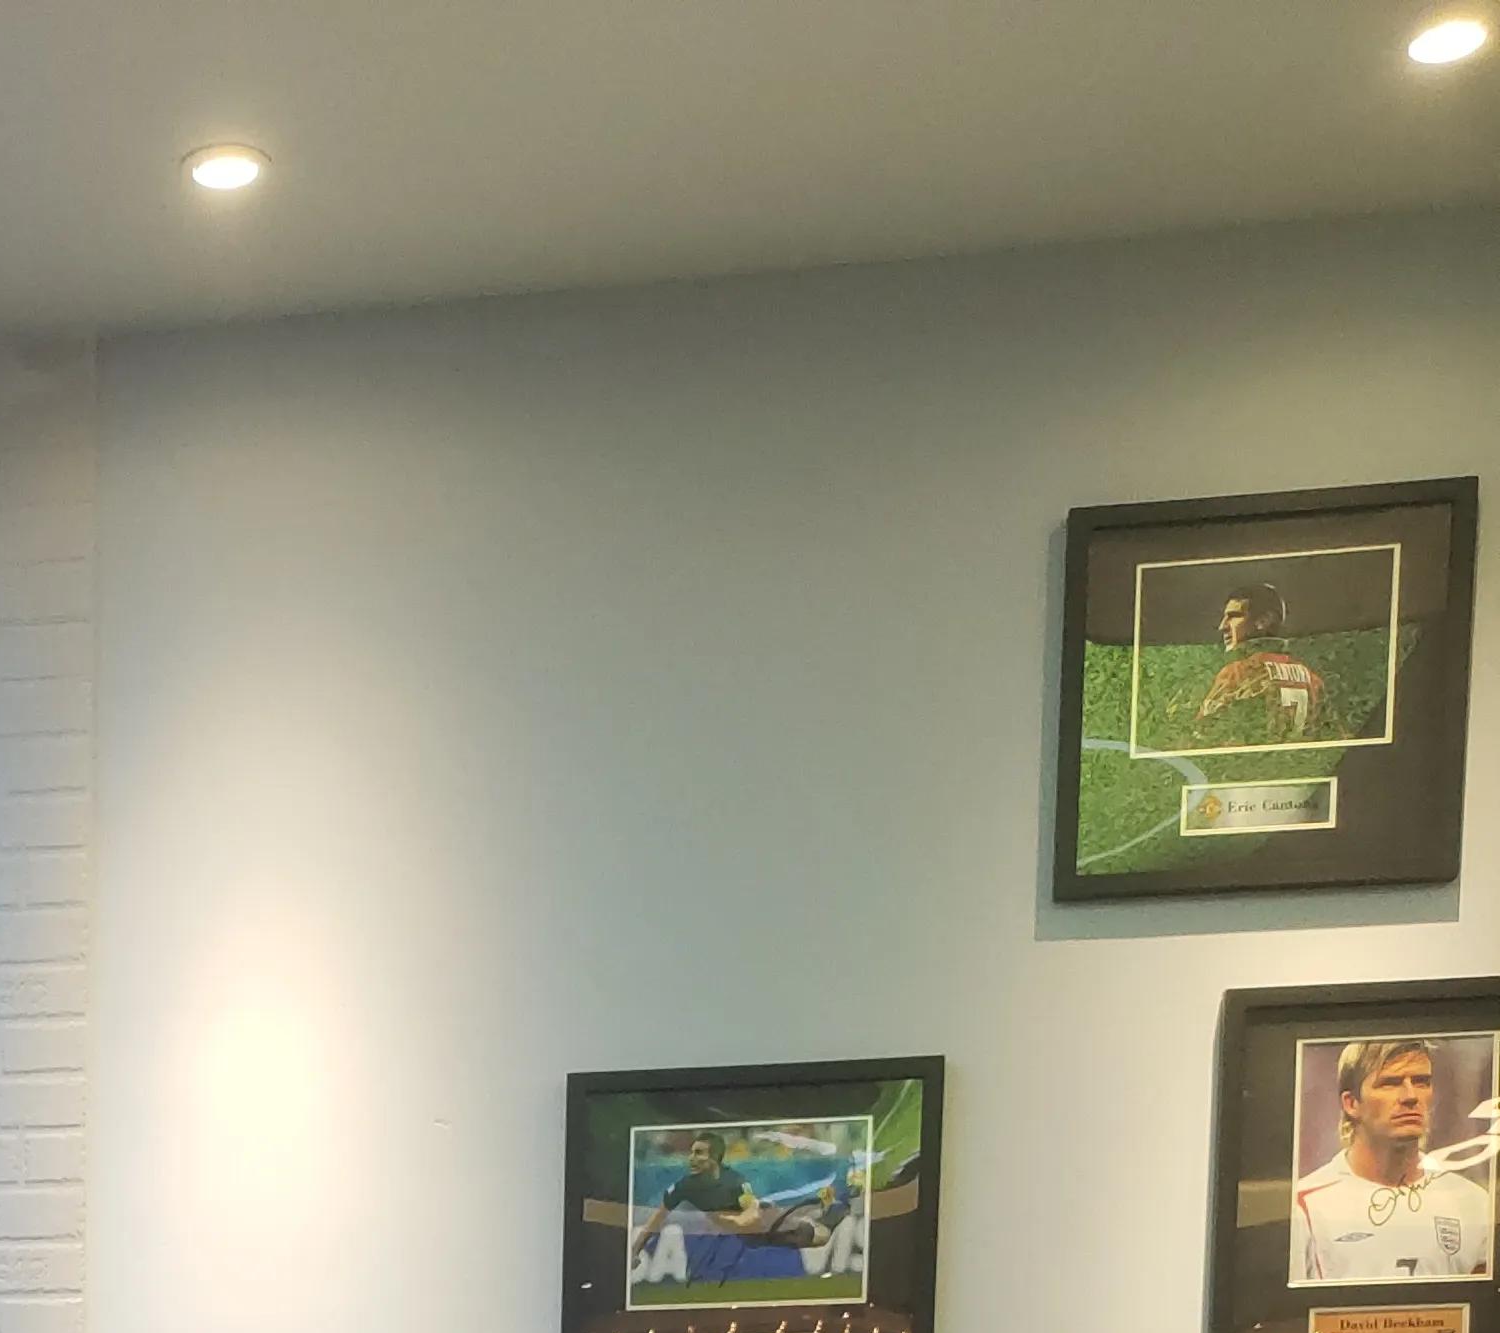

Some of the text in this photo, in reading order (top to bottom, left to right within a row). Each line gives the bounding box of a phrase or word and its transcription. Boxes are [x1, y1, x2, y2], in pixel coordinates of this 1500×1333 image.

[1228, 801, 1255, 813] Eric
[1340, 1318, 1444, 1331] David Beckham
